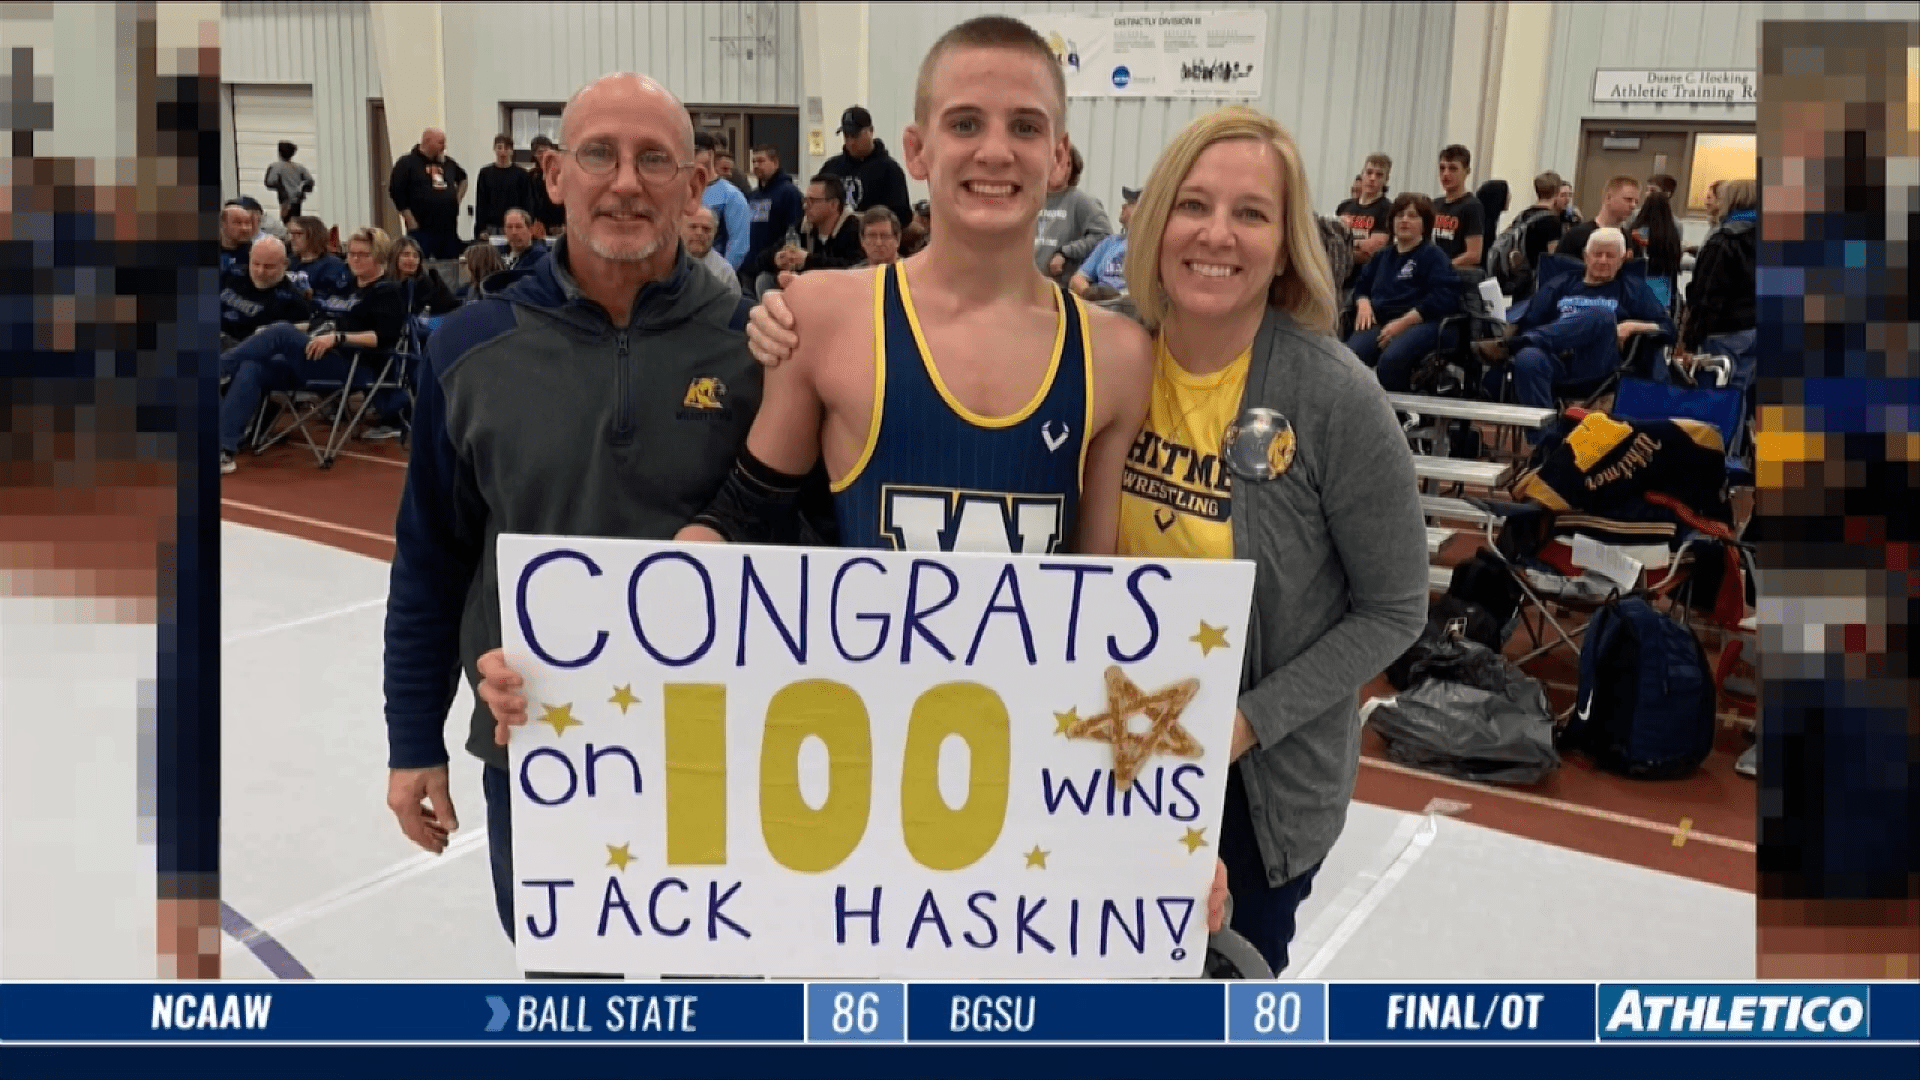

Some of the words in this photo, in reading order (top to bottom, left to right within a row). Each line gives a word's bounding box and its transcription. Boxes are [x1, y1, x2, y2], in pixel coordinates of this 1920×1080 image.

[1158, 17, 1193, 26] DIVISION
[1610, 84, 1669, 98] Athletic
[1673, 84, 1735, 102] Training
[1647, 72, 1682, 84] Duane
[1700, 72, 1749, 86] Hocking
[1122, 472, 1220, 516] WRESTLING
[516, 549, 1172, 668] CONGRATS
[519, 743, 643, 806] on
[664, 678, 1011, 873] 100
[1042, 763, 1205, 821] WINS
[521, 876, 751, 939] JACK
